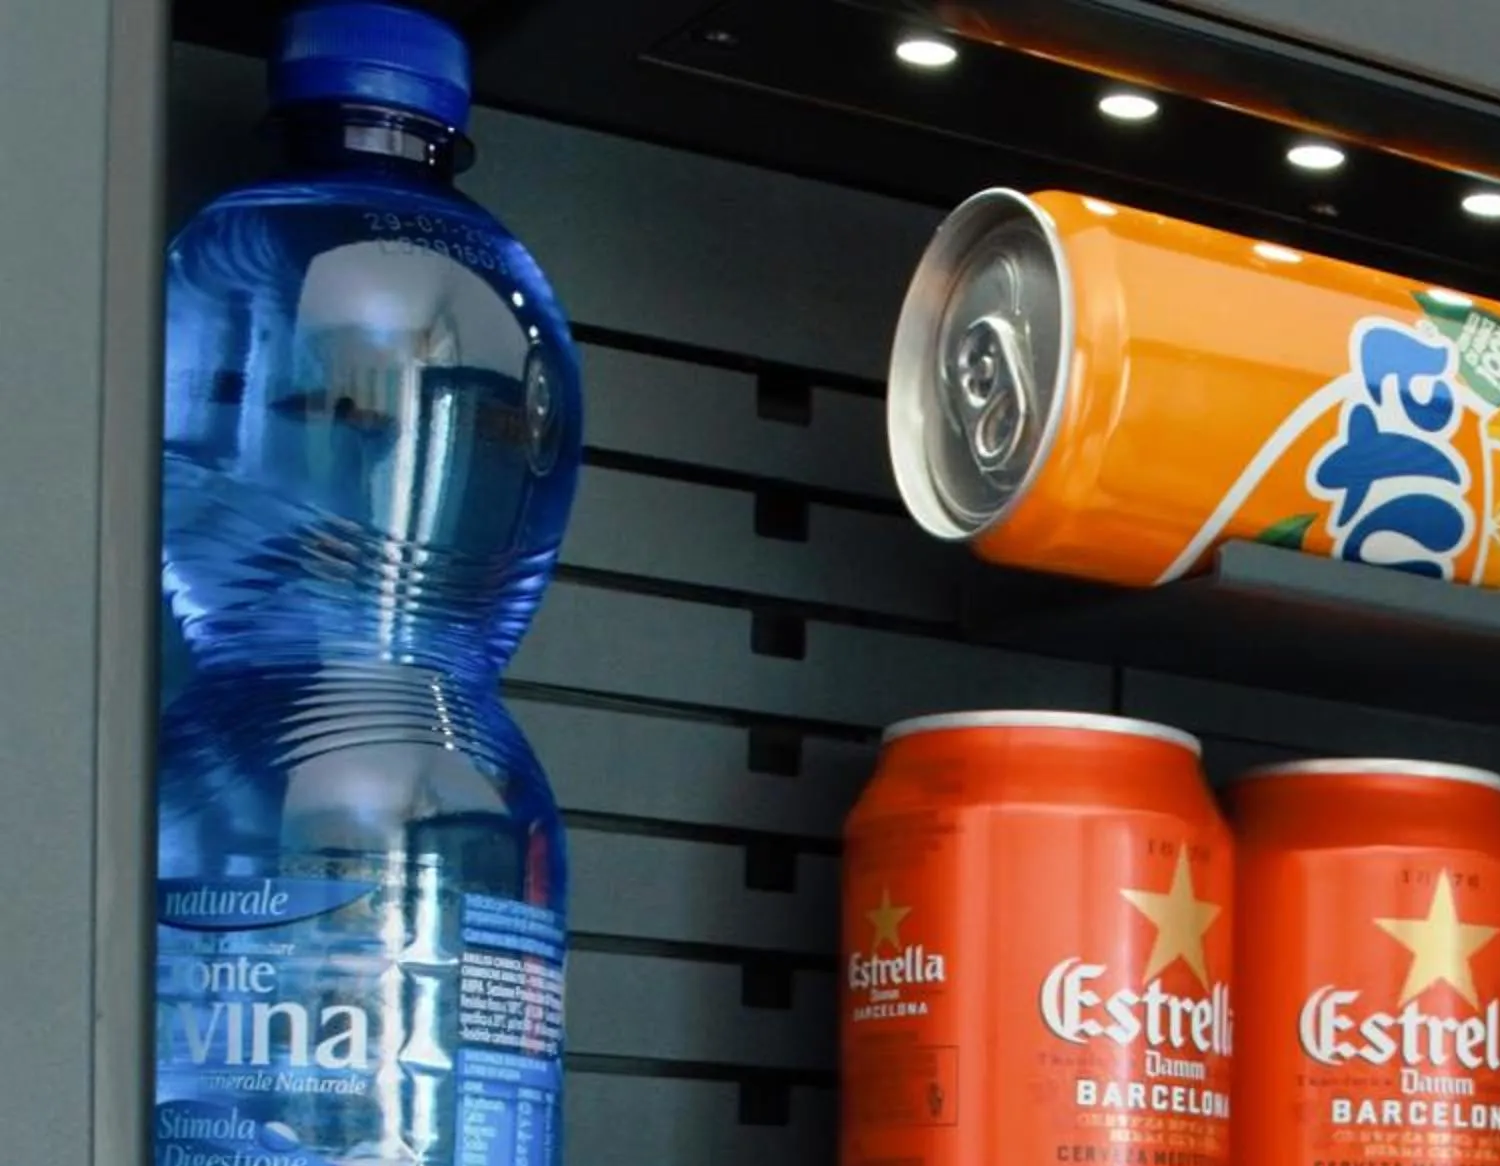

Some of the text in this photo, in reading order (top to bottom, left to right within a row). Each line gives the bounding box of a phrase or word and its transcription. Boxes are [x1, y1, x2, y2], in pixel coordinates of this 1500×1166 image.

[1310, 320, 1472, 580] nta
[164, 878, 290, 917] naturale
[190, 956, 276, 993] onte
[847, 944, 946, 990] Estrella
[853, 1002, 929, 1021] BARCELONA
[1041, 957, 1232, 1057] Estrell
[168, 1000, 369, 1070] vina
[275, 1071, 367, 1096] Naturale
[1145, 1049, 1206, 1081] Damm
[1400, 1067, 1475, 1096] Damm
[157, 1106, 256, 1140] Stimola
